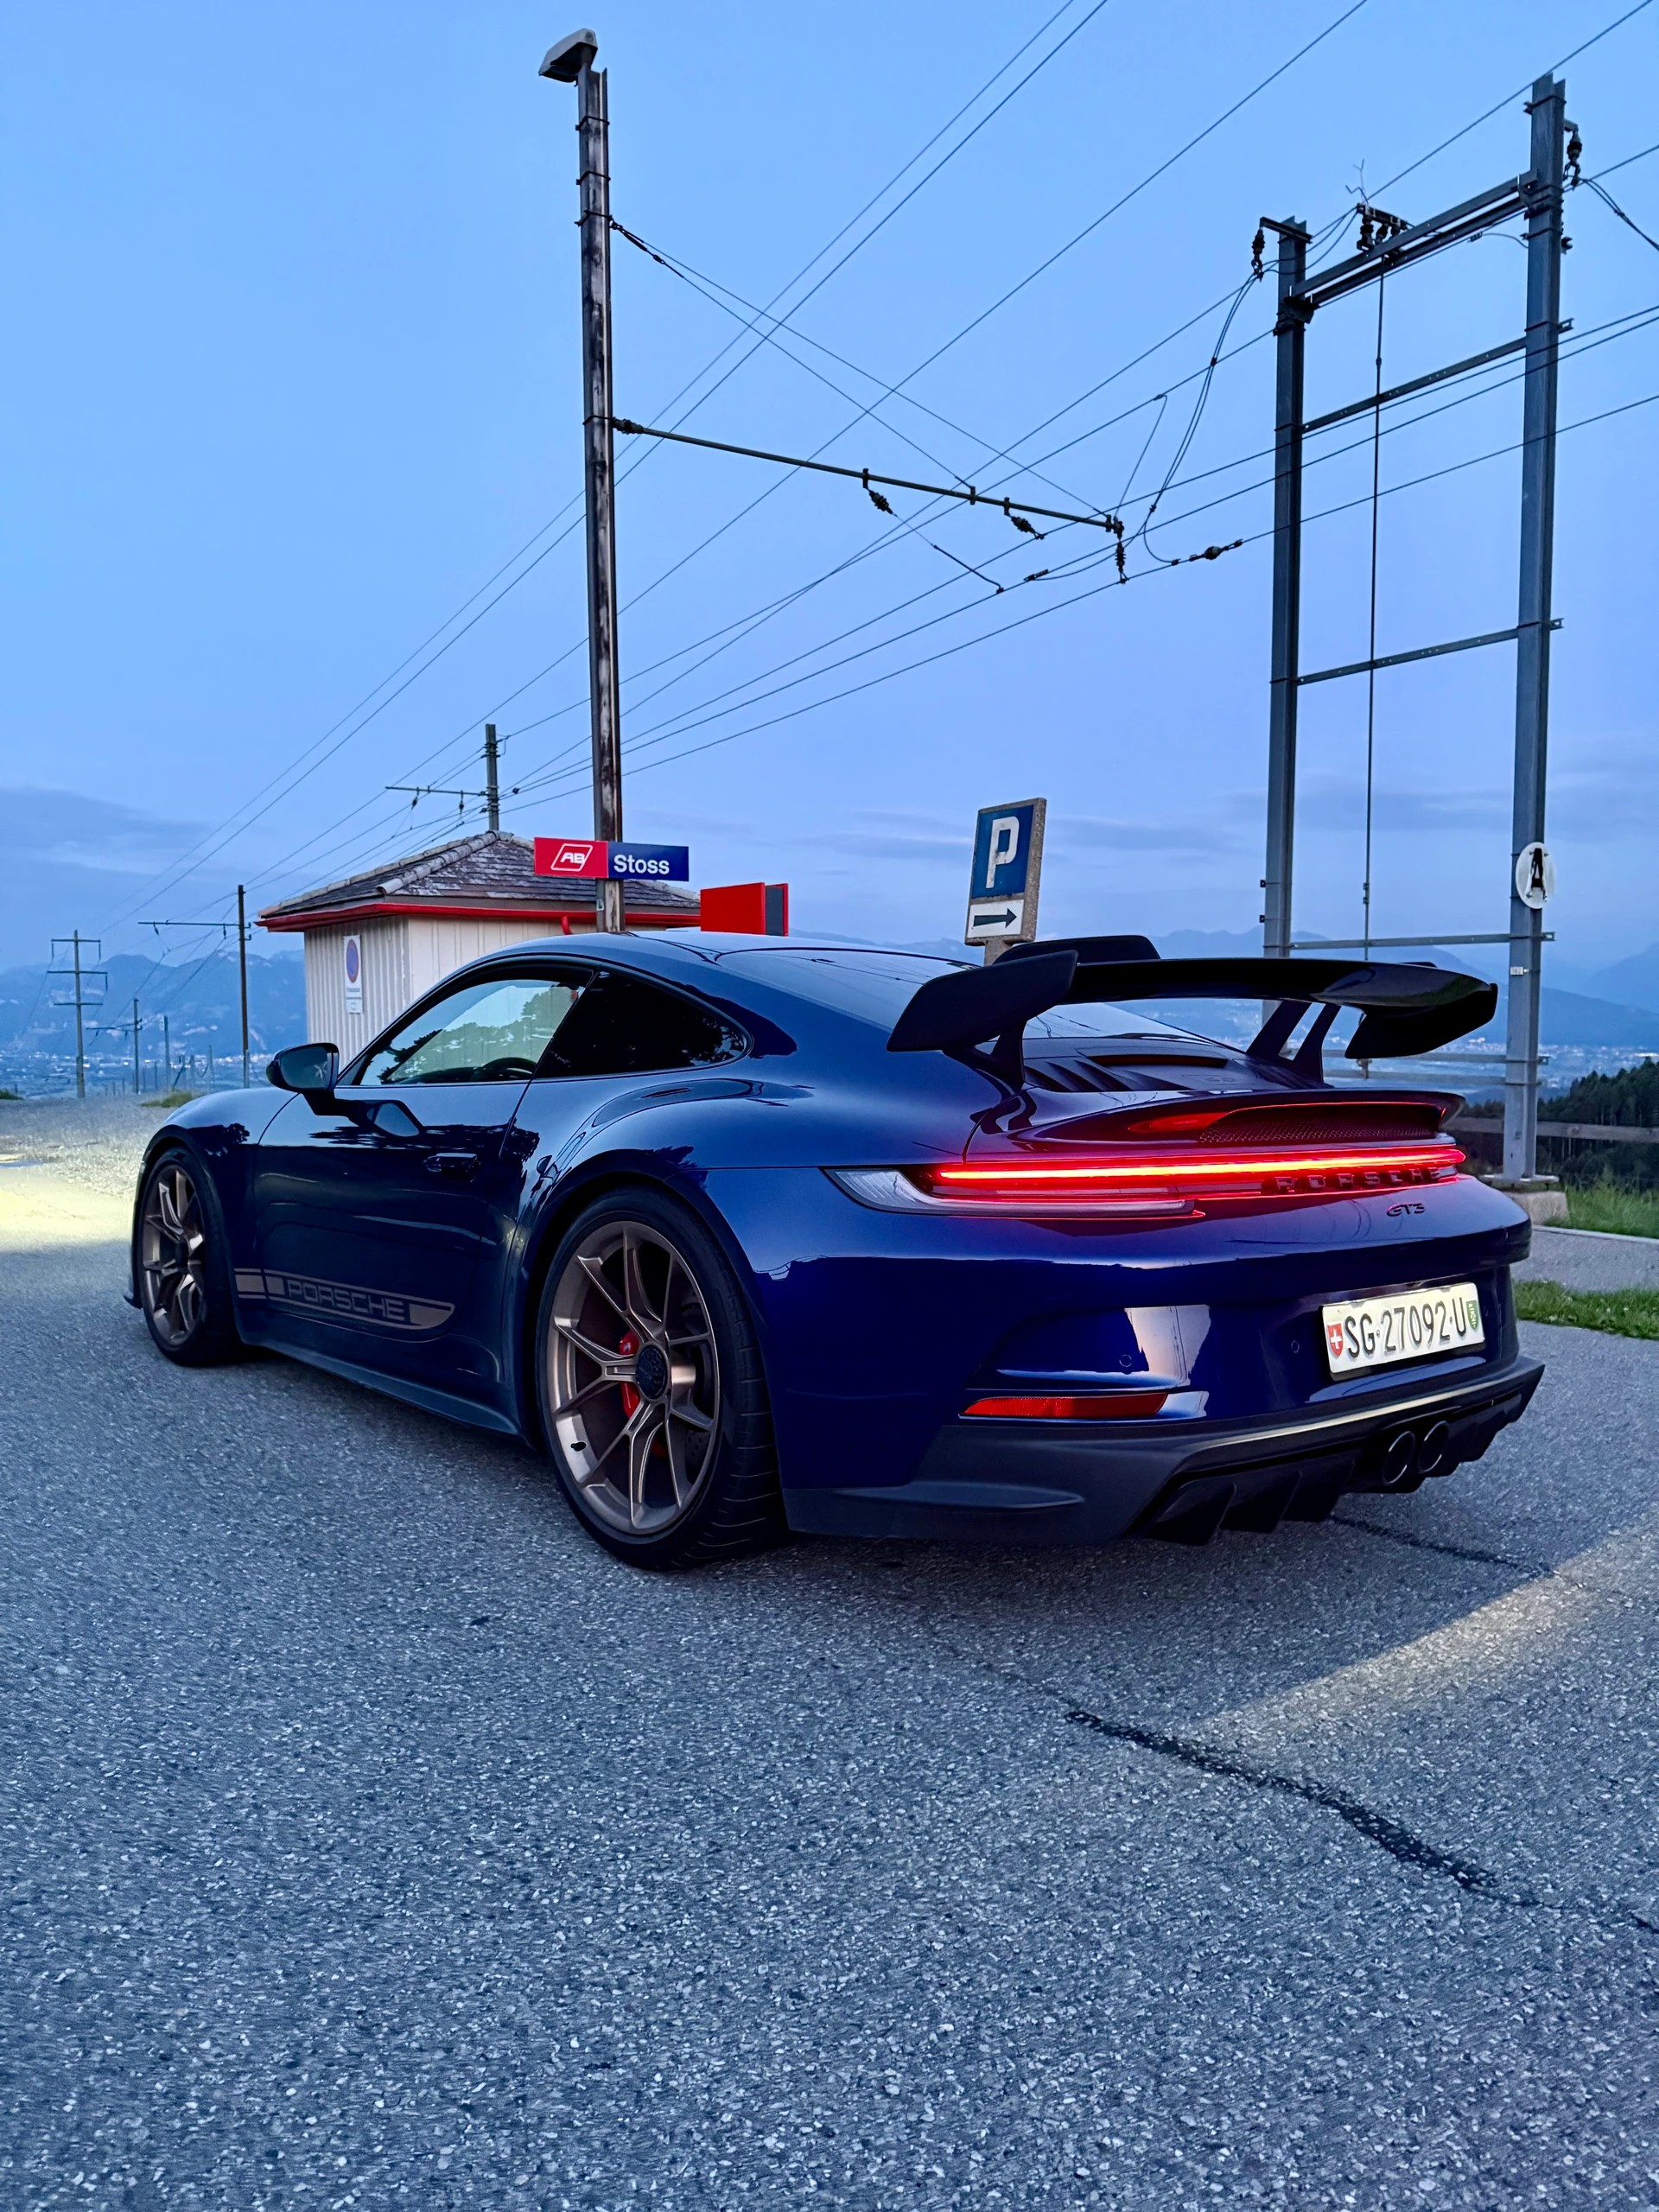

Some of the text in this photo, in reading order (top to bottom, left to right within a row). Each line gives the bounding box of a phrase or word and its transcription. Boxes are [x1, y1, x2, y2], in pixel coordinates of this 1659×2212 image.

[560, 852, 585, 864] AB
[986, 816, 1020, 888] P
[613, 854, 670, 874] Stoss
[1275, 1166, 1441, 1192] PORSCHE
[1386, 1203, 1425, 1217] GT3
[287, 1279, 405, 1321] PORSCHE
